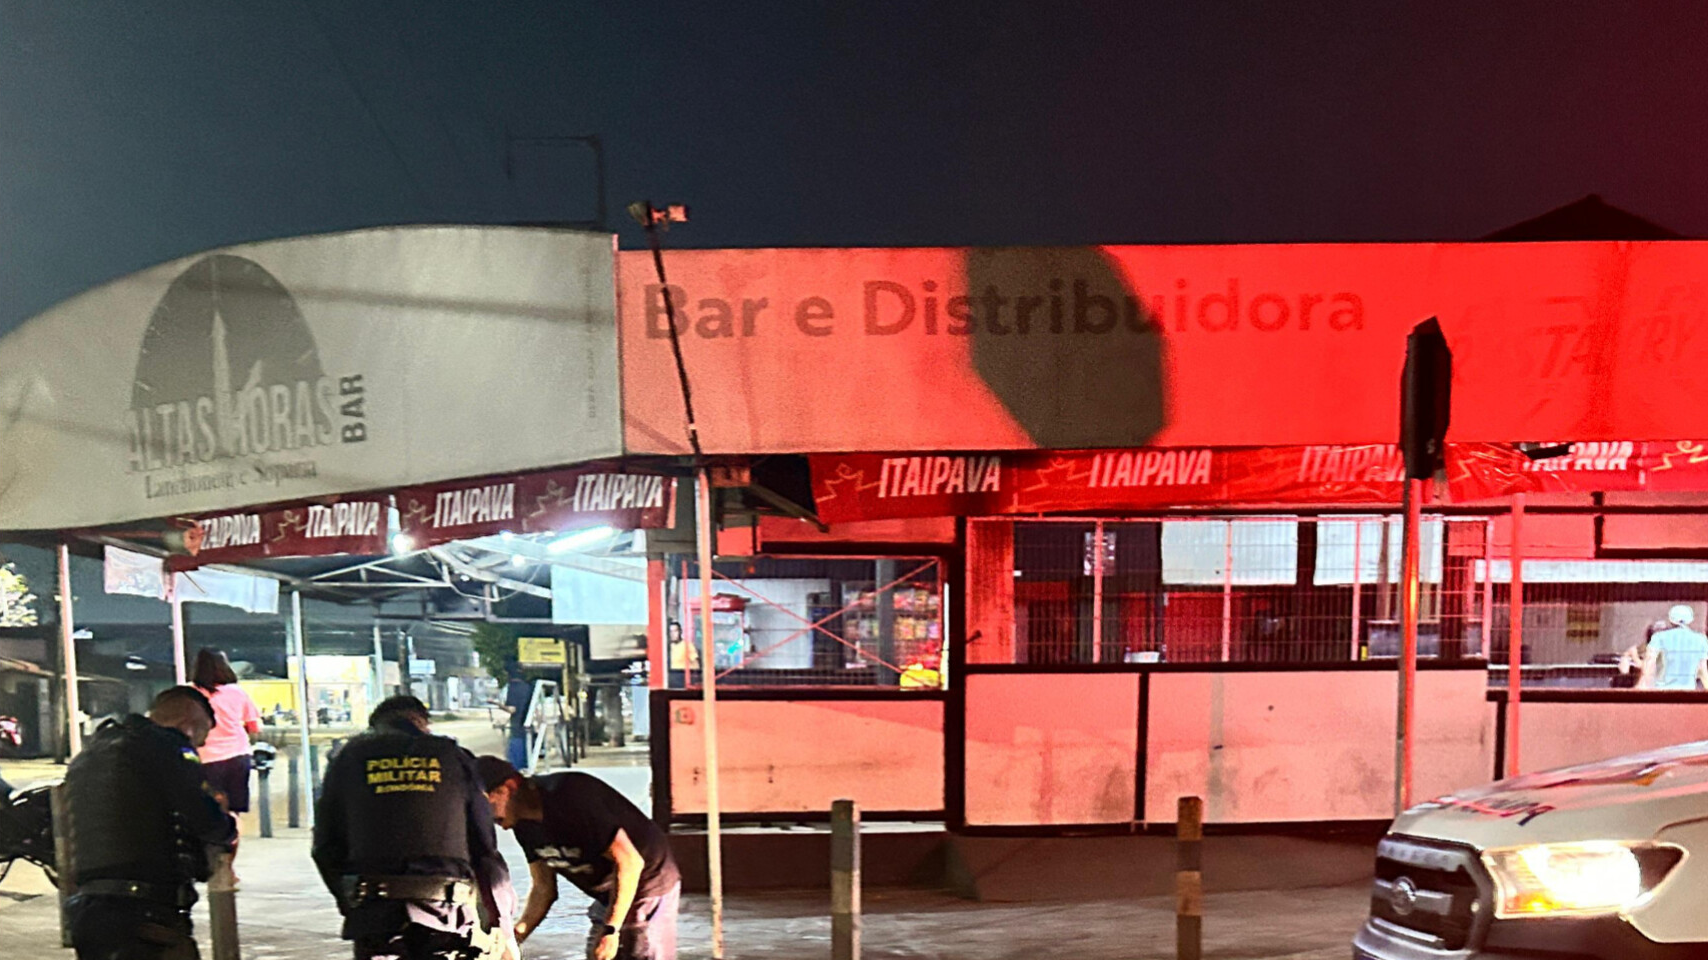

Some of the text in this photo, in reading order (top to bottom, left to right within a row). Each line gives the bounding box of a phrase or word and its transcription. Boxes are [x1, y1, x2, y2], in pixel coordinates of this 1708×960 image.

[644, 278, 1365, 339] Bar e Distribuidora
[338, 373, 368, 444] BAR
[878, 456, 1002, 499] ITAIPAVA
[1088, 450, 1213, 488] ITAIPAVA
[432, 483, 515, 528] ITAIPAVA
[573, 473, 663, 512] ITAIPAVA
[200, 513, 260, 550] TAIPAVA
[305, 501, 380, 538] ITAIPAVA
[367, 769, 441, 785] MILITAR
